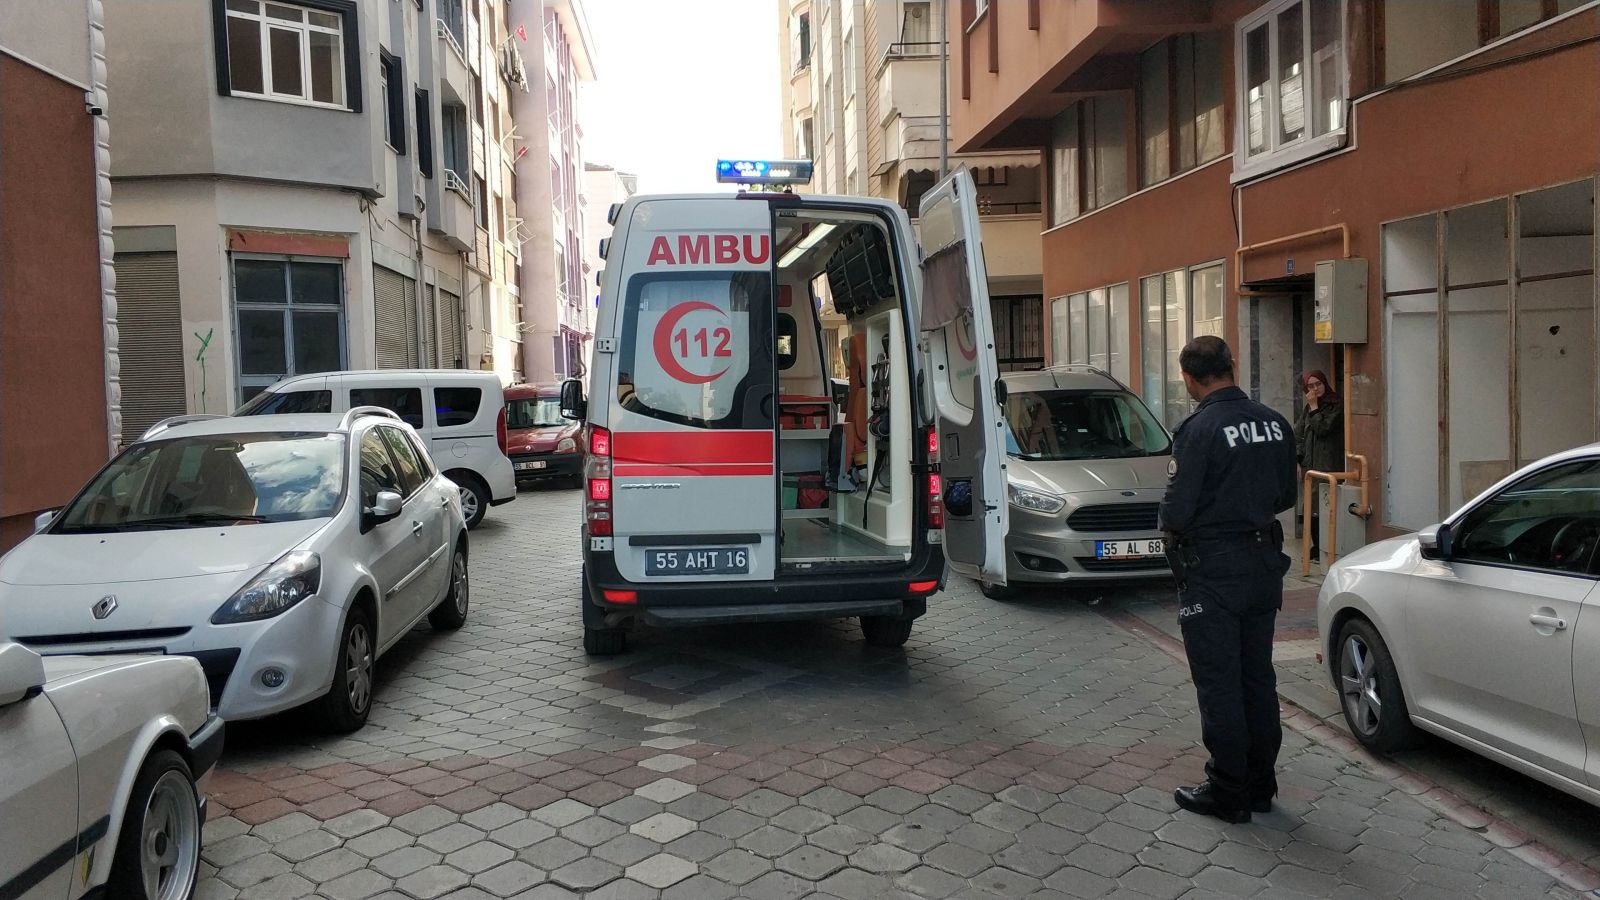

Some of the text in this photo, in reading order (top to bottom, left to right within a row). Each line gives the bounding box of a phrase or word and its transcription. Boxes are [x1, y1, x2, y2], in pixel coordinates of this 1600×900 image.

[646, 234, 770, 266] AMBU
[674, 327, 732, 358] 112
[1104, 540, 1165, 555] 55 AL 68
[656, 551, 746, 569] 55 AHT 16
